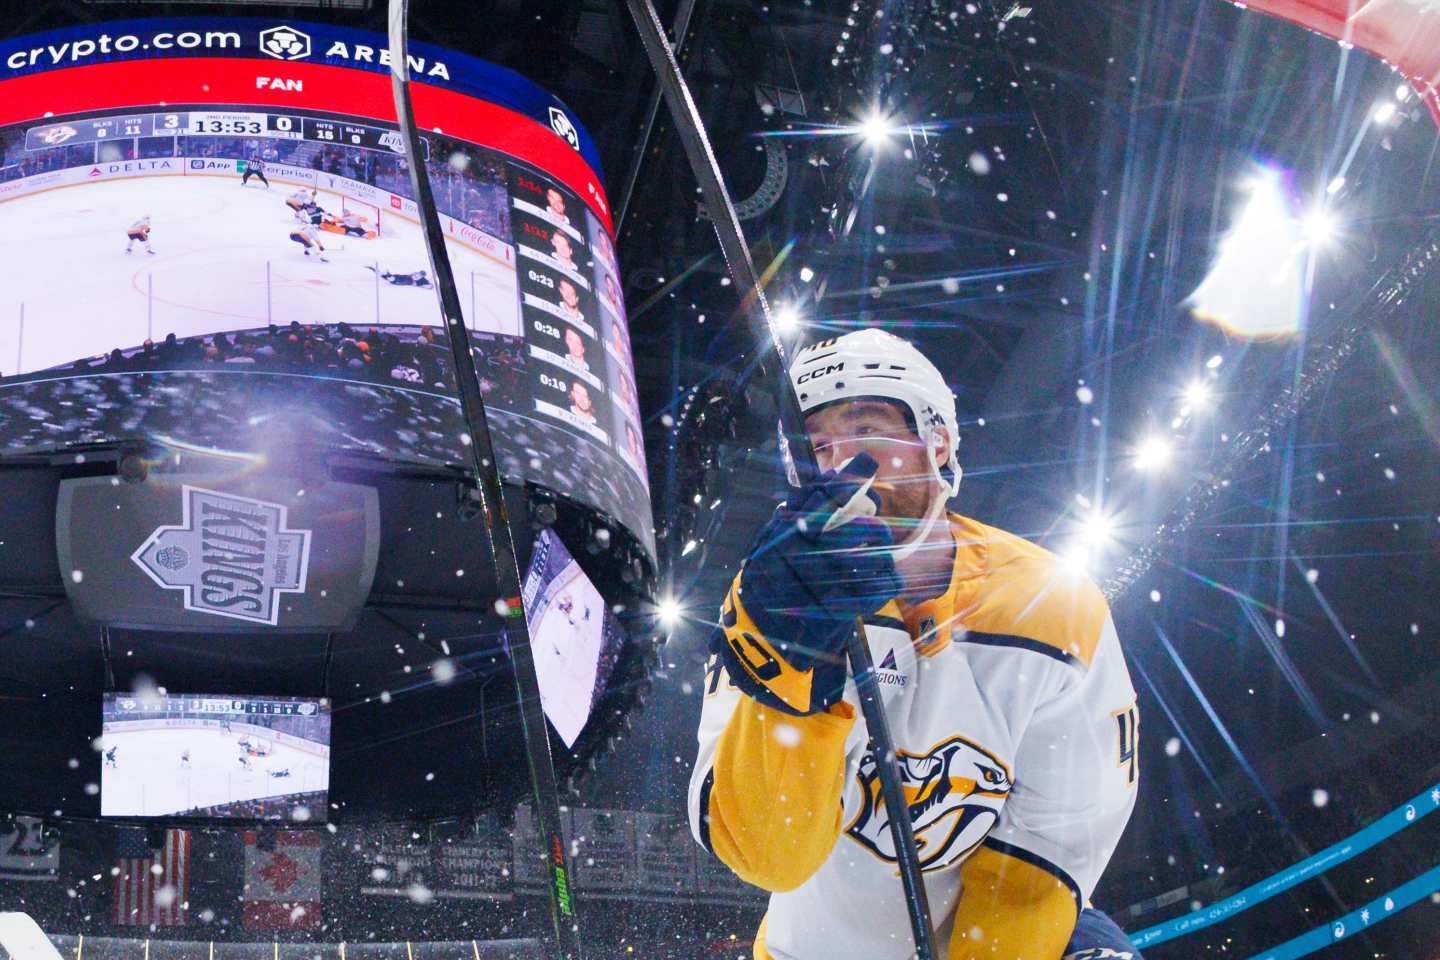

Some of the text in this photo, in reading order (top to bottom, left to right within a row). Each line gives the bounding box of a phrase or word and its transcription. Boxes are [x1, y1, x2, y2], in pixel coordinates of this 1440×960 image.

[7, 30, 450, 80] crypto.com ARENA
[256, 76, 303, 92] FAN
[125, 118, 142, 126] HITS
[164, 114, 179, 129] 3
[196, 120, 262, 134] 13:53
[276, 117, 292, 131] 0
[316, 122, 334, 130] HITS
[125, 126, 141, 135] 11
[317, 130, 334, 140] 15
[346, 126, 365, 135] BLKS
[110, 160, 172, 173] DELTA
[207, 160, 231, 169] App
[528, 269, 554, 288] 0:23
[534, 321, 560, 338] 0:28
[797, 362, 844, 385] CCM
[201, 502, 268, 612] KINGS
[876, 672, 907, 687] GIONS
